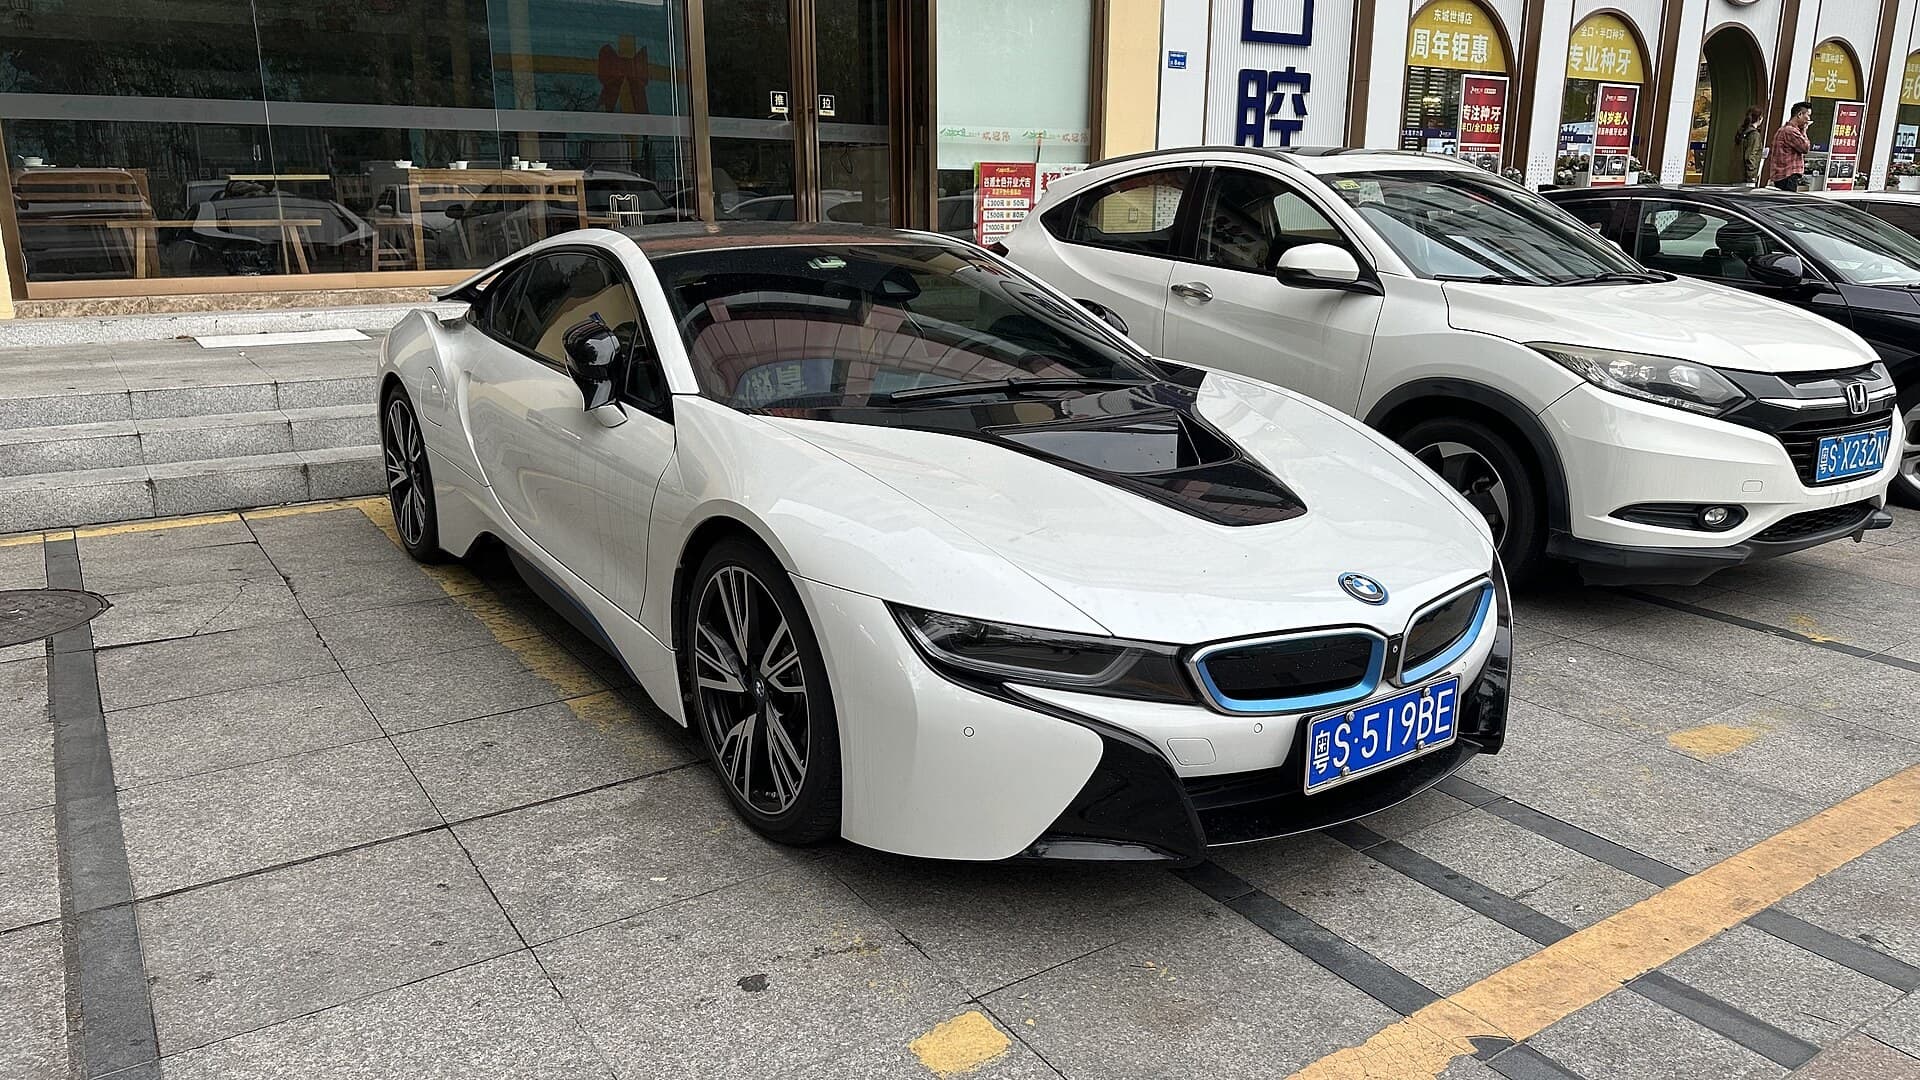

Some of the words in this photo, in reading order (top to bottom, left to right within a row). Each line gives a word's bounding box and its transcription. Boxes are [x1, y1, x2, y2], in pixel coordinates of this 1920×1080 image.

[1433, 8, 1473, 25] 东城世博店
[1411, 28, 1489, 64] 周年钜惠
[1569, 43, 1632, 76] 专业种牙
[774, 93, 785, 106] 推
[822, 97, 832, 109] 拉
[1462, 104, 1502, 122] 专注种牙
[1598, 110, 1629, 126] 94岁老人
[1312, 688, 1454, 774] 粤S·519BE
